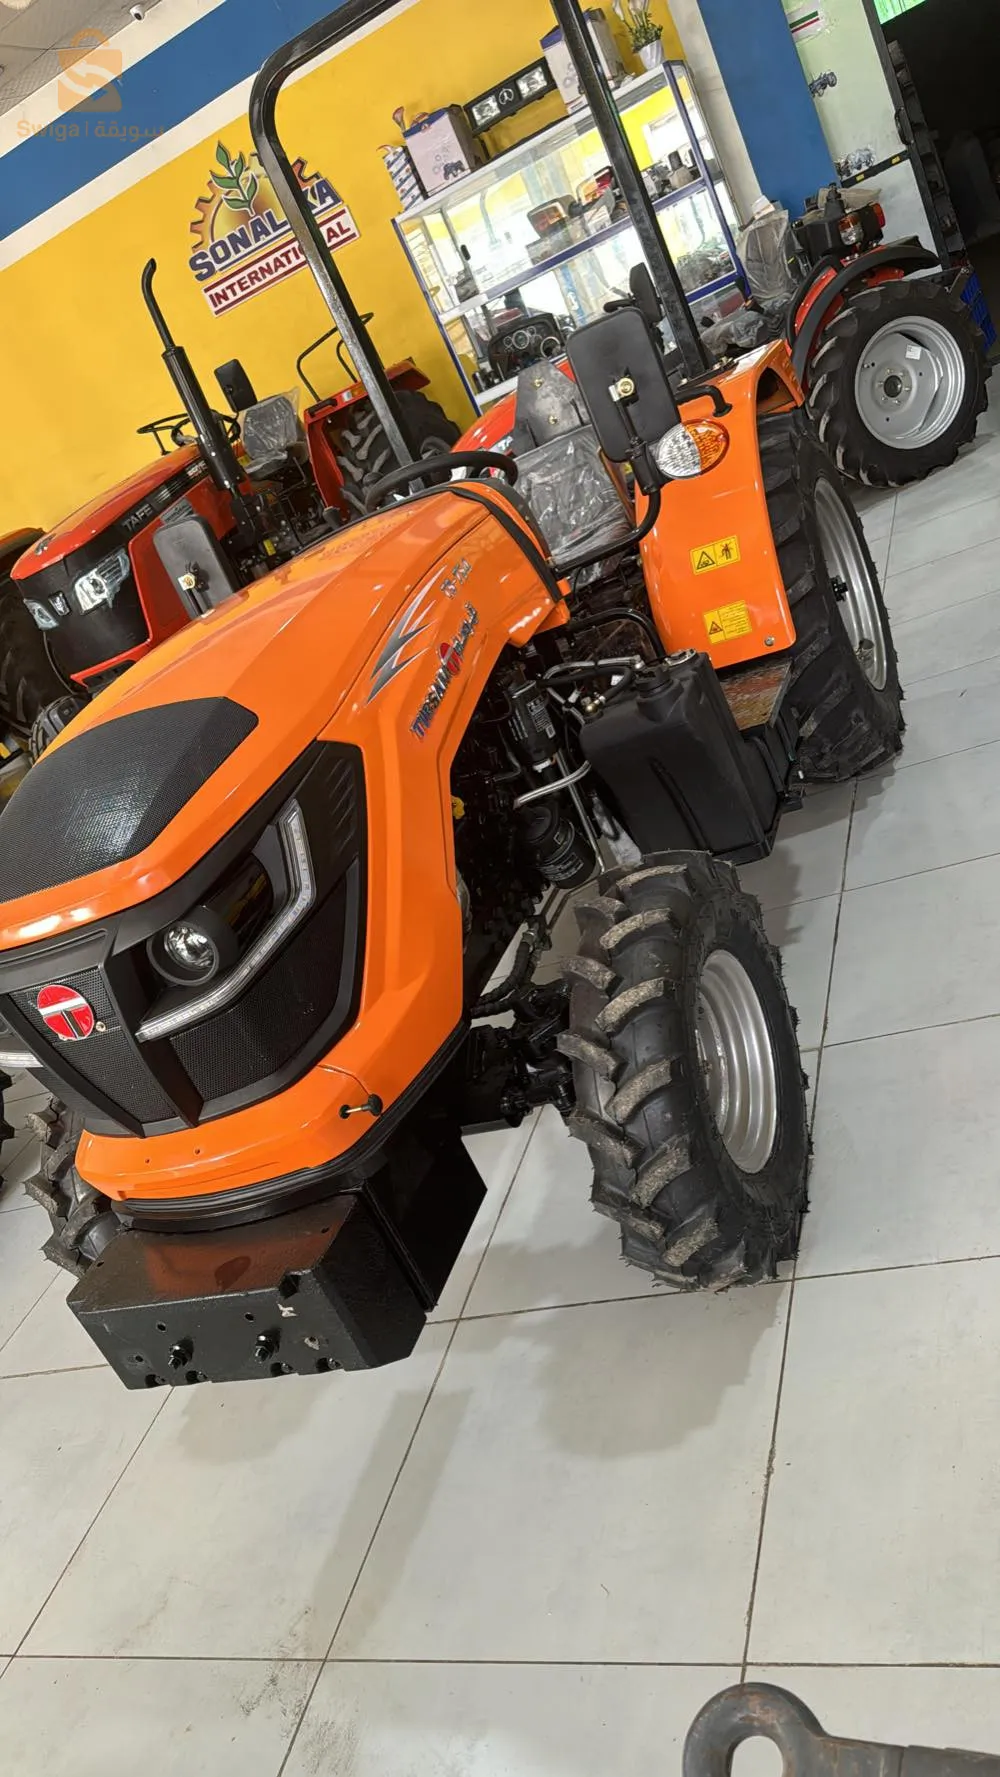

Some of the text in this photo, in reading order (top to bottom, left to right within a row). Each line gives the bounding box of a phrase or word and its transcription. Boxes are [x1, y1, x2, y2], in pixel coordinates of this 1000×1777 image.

[189, 180, 342, 281] SONALKA
[208, 221, 351, 308] INTERNATIAL
[122, 503, 154, 531] TAFE
